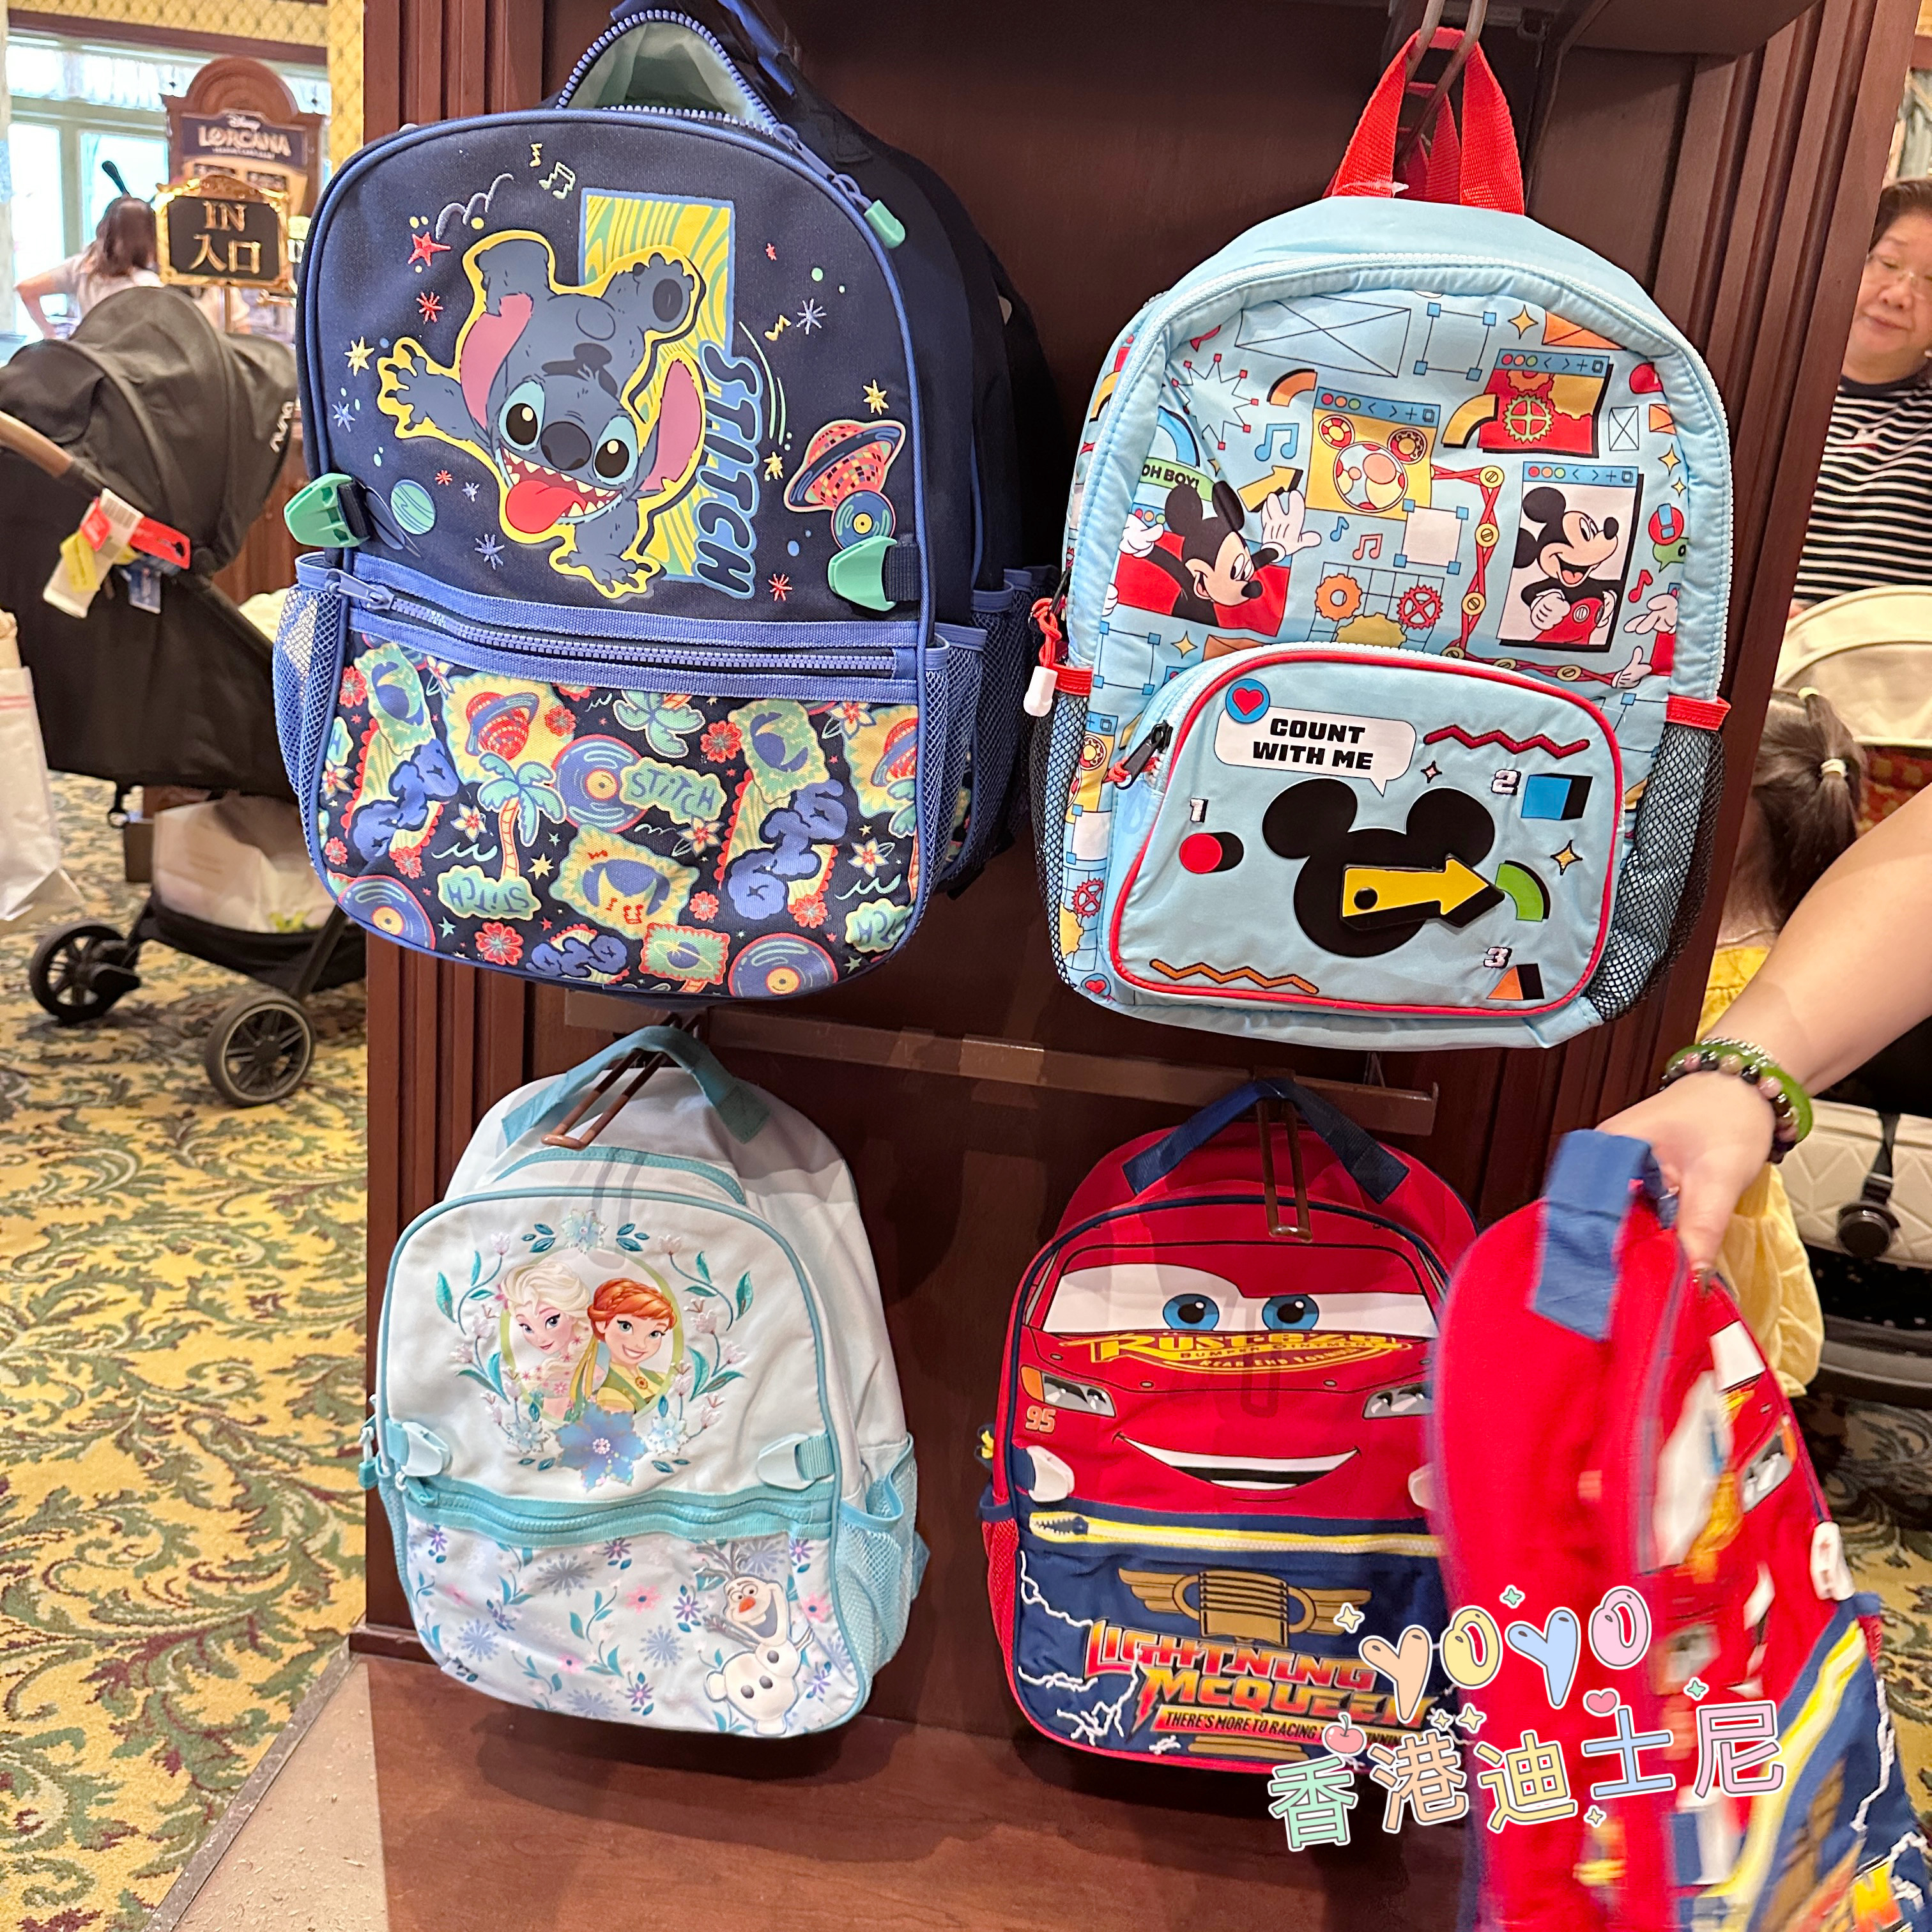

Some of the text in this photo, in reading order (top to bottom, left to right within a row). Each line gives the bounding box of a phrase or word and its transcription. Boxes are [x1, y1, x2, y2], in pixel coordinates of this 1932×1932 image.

[198, 125, 292, 157] LORCANA
[203, 200, 246, 232] IN
[188, 234, 262, 275] 入口
[695, 344, 760, 594] STITCH
[1142, 464, 1162, 479] OH
[1269, 717, 1366, 744] COUNT
[1253, 740, 1374, 770] WITH ME
[1491, 769, 1521, 795] 2
[1190, 797, 1209, 823] 1
[1483, 946, 1512, 969] 3
[1025, 1405, 1056, 1434] 95
[1084, 1618, 1377, 1692] LIGHTNING
[1165, 1710, 1215, 1730] THERE'S
[1216, 1714, 1251, 1732] MORE
[1252, 1717, 1267, 1734] TO
[1268, 1720, 1317, 1740] RACING
